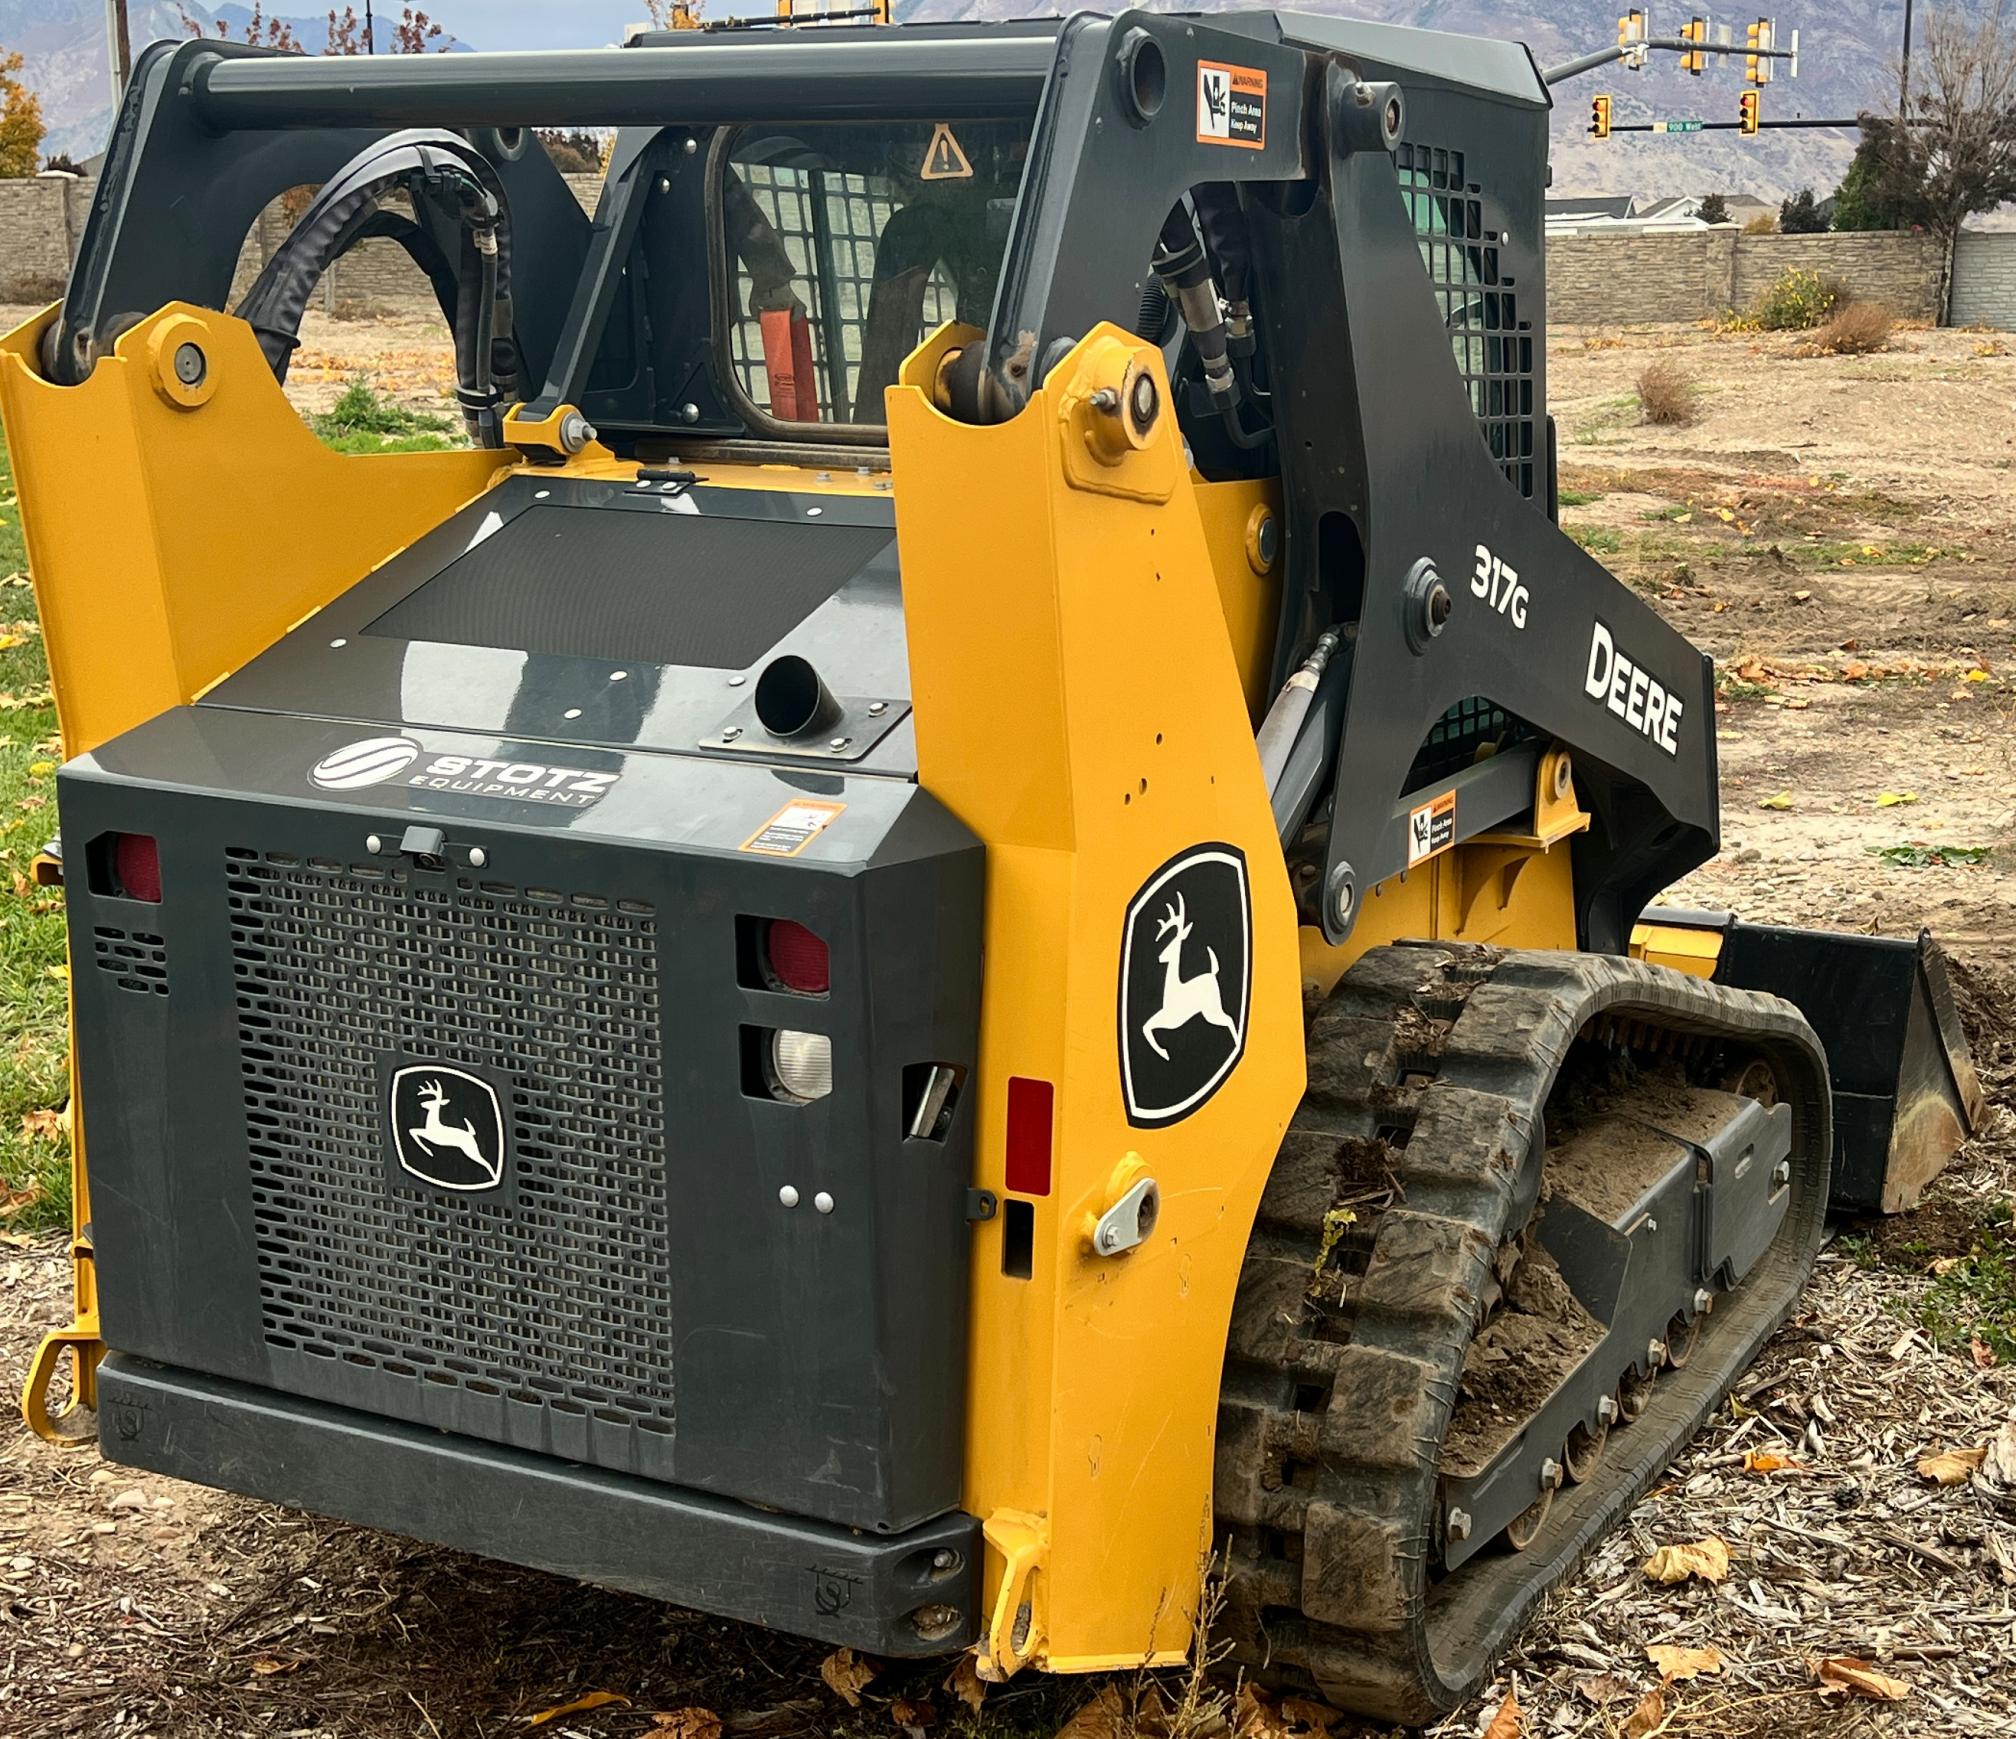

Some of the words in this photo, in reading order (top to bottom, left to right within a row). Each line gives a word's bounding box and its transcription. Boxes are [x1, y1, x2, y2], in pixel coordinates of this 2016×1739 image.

[1238, 75, 1263, 88] WARNING
[1231, 101, 1247, 114] Pinch
[1248, 104, 1262, 117] Area
[1231, 118, 1243, 131] Keep
[1244, 120, 1257, 134] Away
[1470, 544, 1530, 629] 317G
[1585, 621, 1683, 756] DEERE
[425, 756, 622, 793] STOTZ
[408, 775, 596, 805] EQUIPMENT
